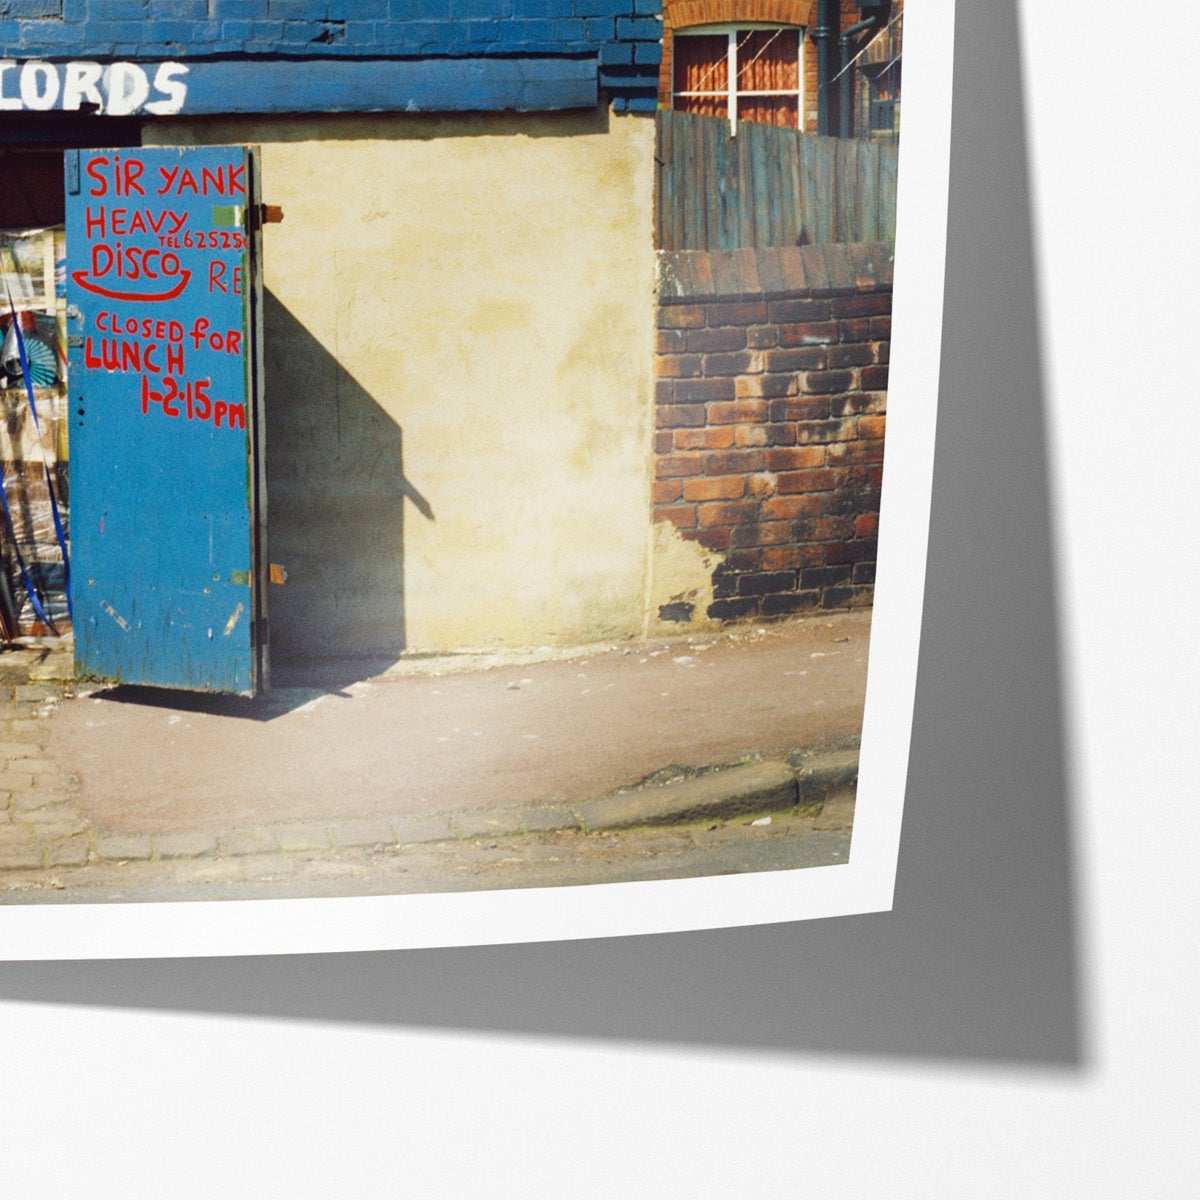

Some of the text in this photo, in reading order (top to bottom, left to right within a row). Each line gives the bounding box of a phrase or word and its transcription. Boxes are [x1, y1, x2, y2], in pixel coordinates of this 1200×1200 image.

[157, 163, 246, 197] YANK
[86, 205, 189, 239] HEAVY
[158, 235, 181, 249] TEL
[96, 311, 184, 343] CLOSED
[85, 336, 185, 376] LUNCH
